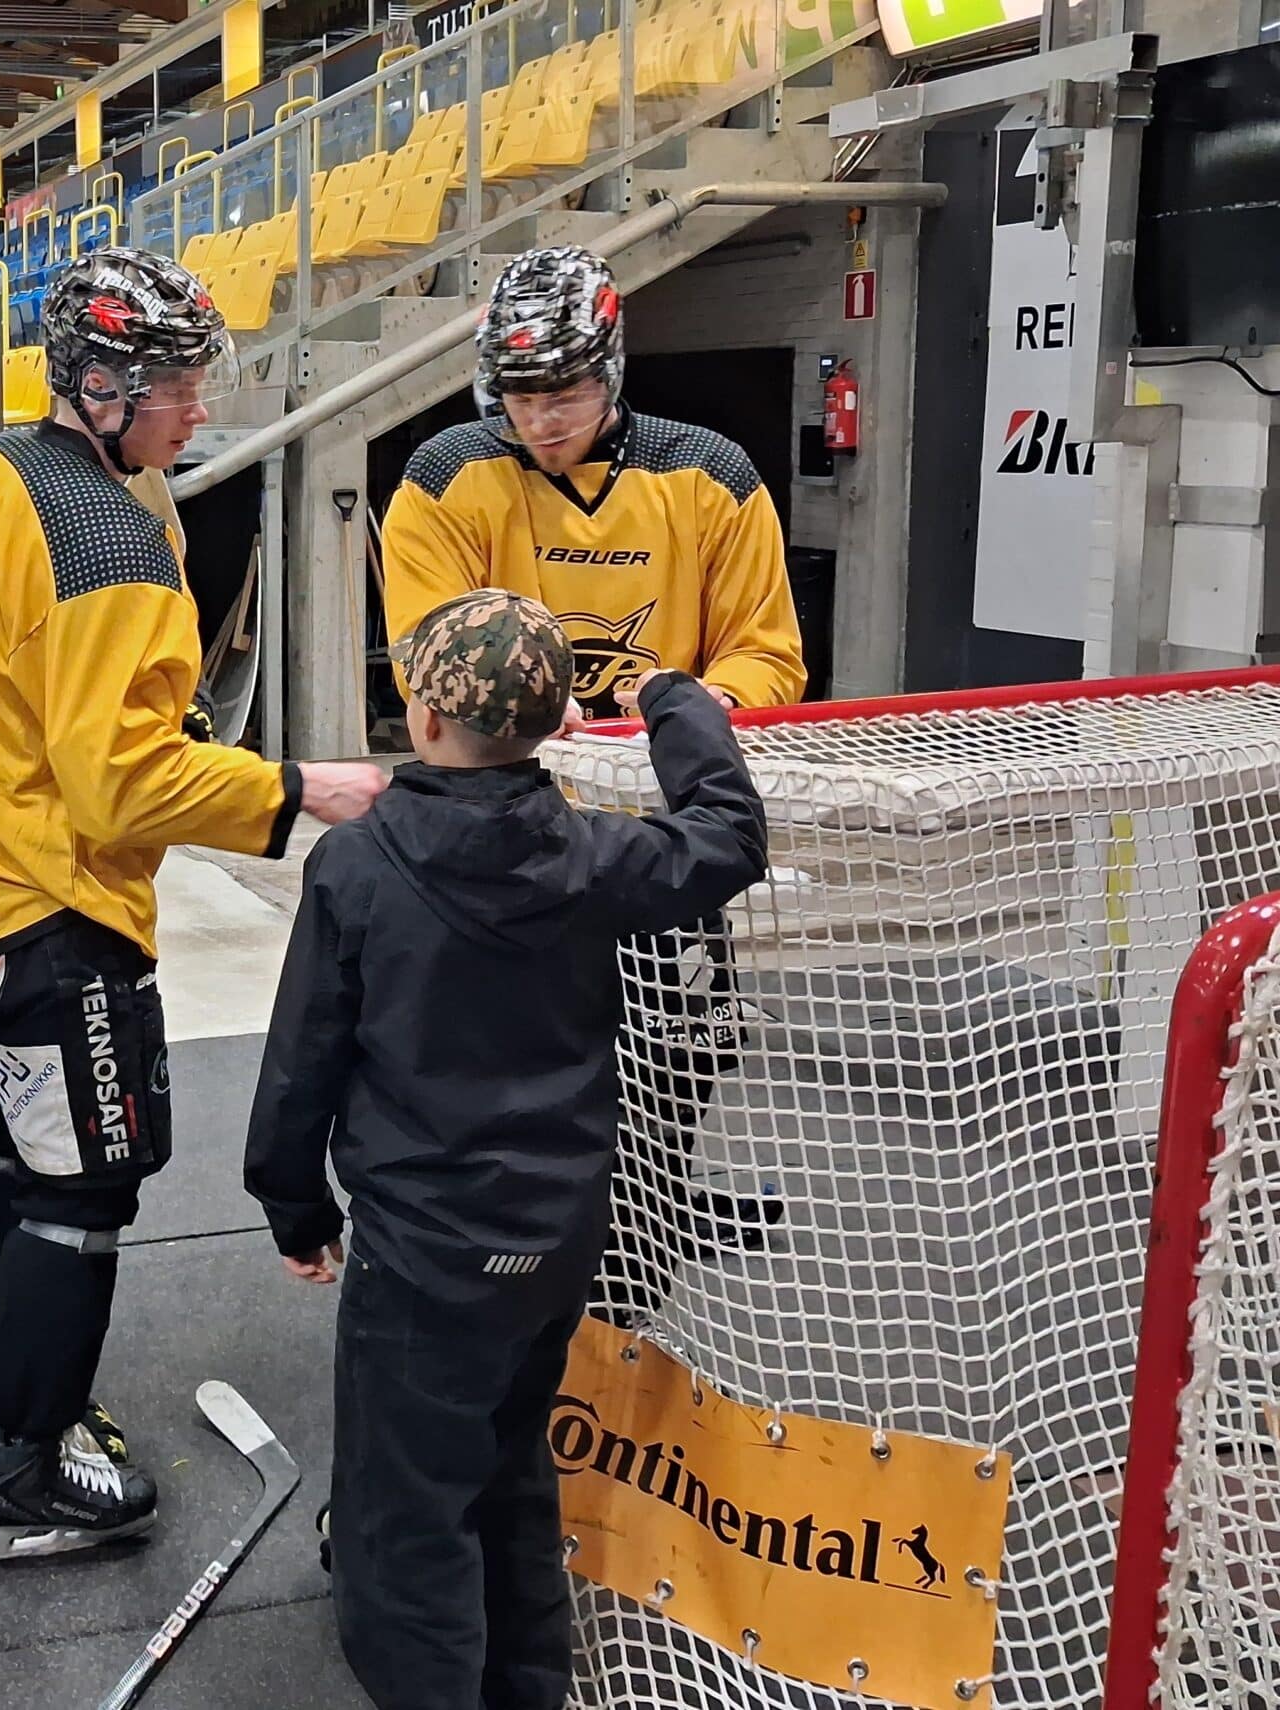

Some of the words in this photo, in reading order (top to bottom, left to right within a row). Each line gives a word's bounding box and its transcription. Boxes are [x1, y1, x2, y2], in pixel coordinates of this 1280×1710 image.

[87, 332, 135, 354] BAUER
[1016, 302, 1075, 350] RE
[545, 546, 651, 566] BAUER
[81, 974, 130, 1163] TEKNOSAFE
[145, 1559, 229, 1660] BAUER
